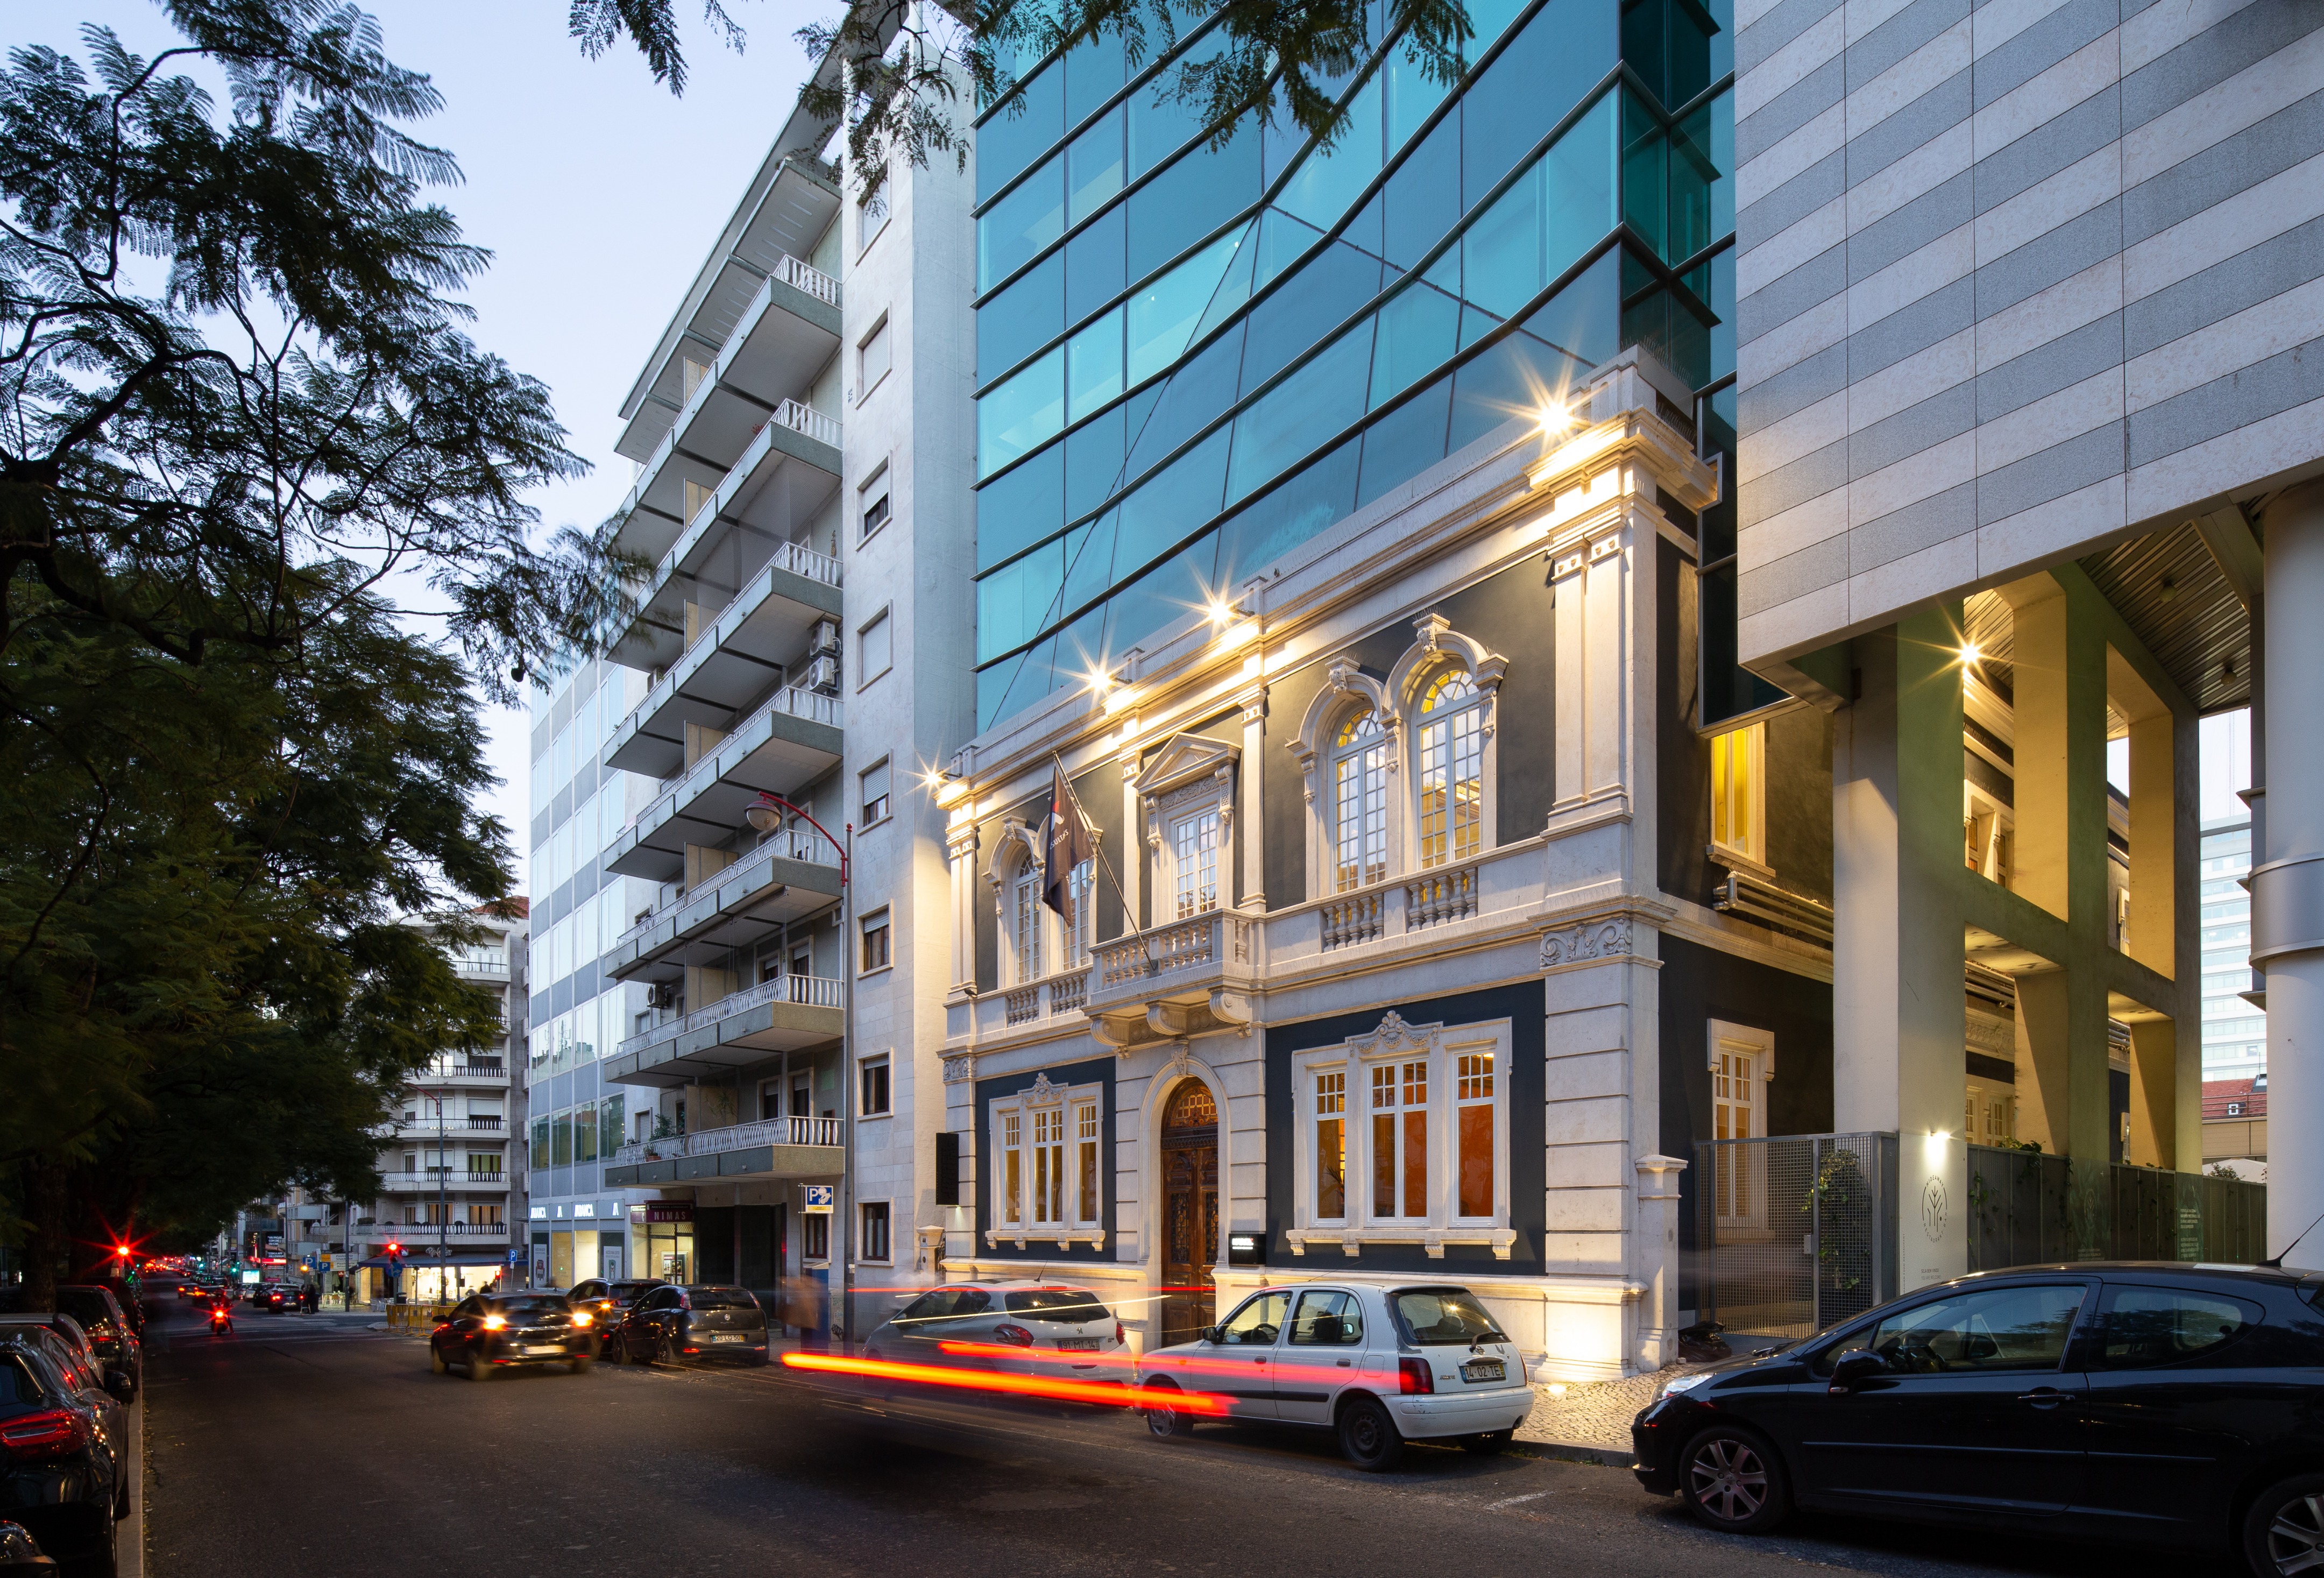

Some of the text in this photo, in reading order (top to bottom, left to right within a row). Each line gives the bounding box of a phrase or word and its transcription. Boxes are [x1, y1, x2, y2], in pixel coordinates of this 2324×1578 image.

[1926, 1175, 1943, 1187] HIDEAWAY
[810, 1188, 818, 1201] P
[654, 1212, 686, 1220] NIMAS
[511, 1251, 515, 1260] P
[306, 1258, 313, 1266] P
